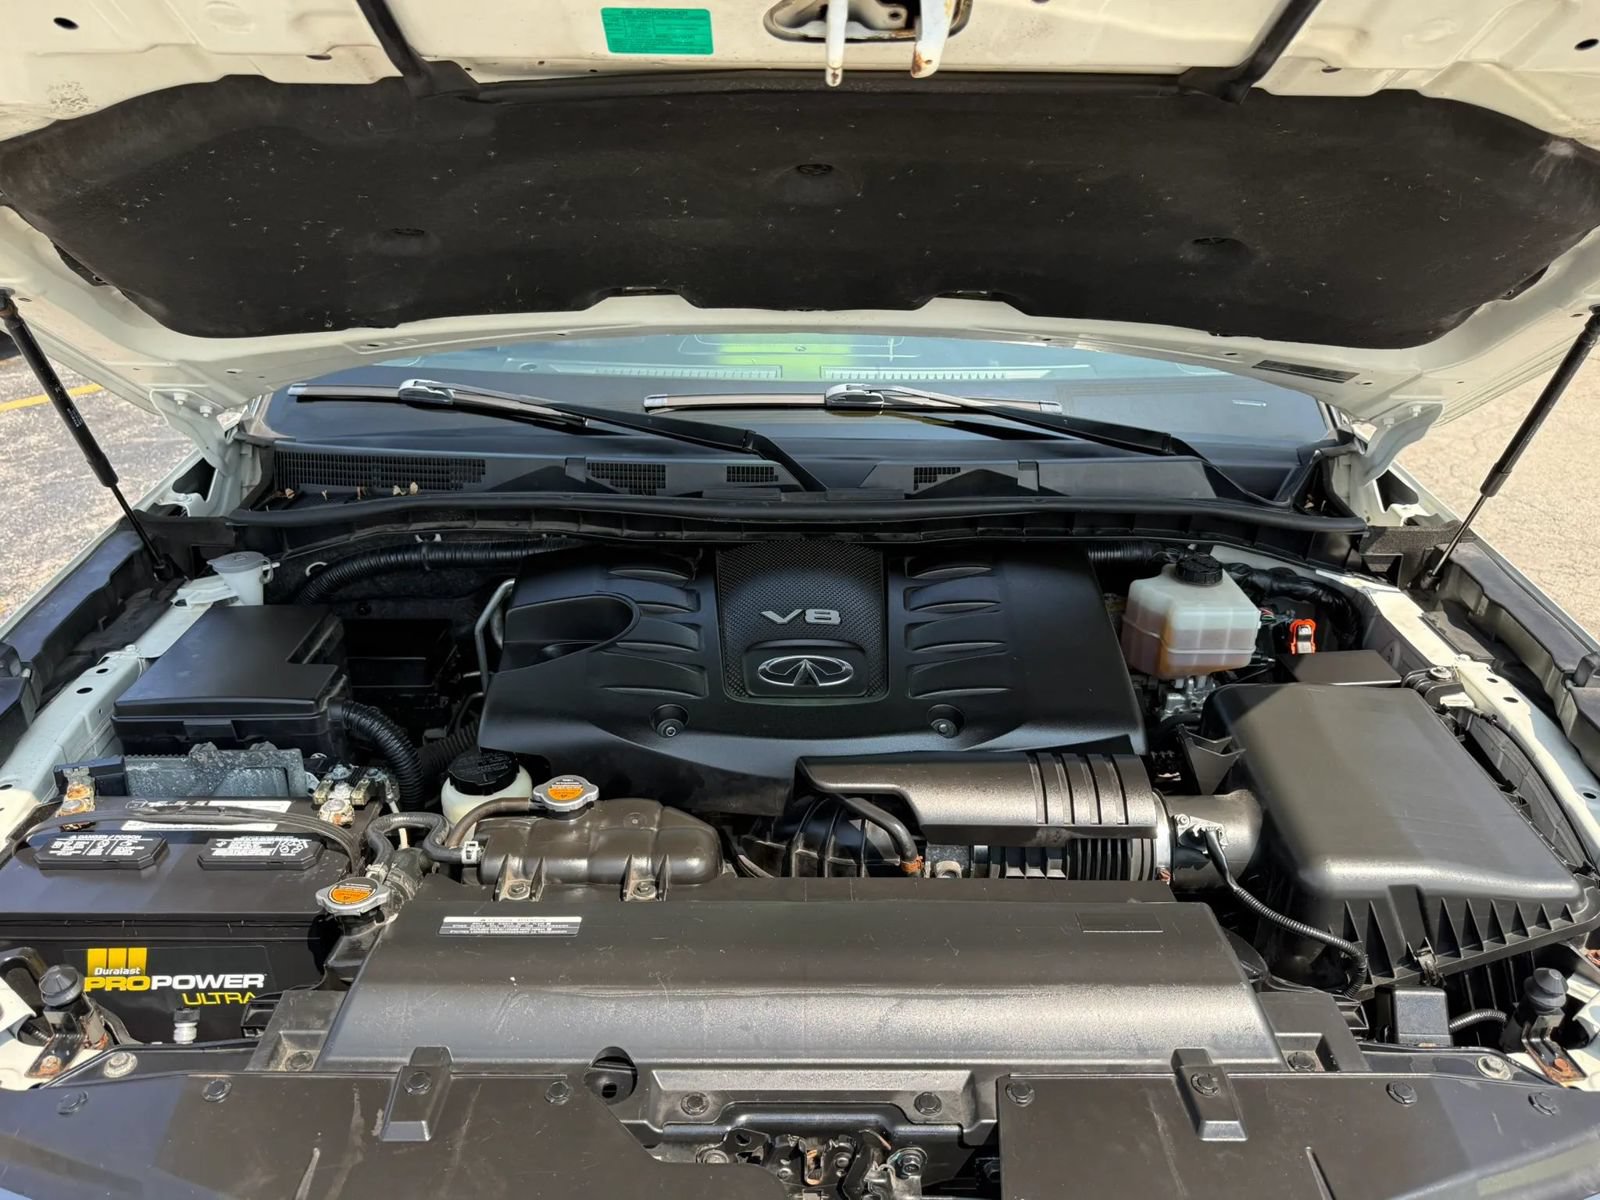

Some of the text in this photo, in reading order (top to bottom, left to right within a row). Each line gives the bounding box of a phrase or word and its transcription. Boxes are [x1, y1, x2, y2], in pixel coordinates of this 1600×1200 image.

[760, 608, 841, 625] V8
[94, 966, 141, 976] Duralast
[182, 991, 256, 1006] ULTRA
